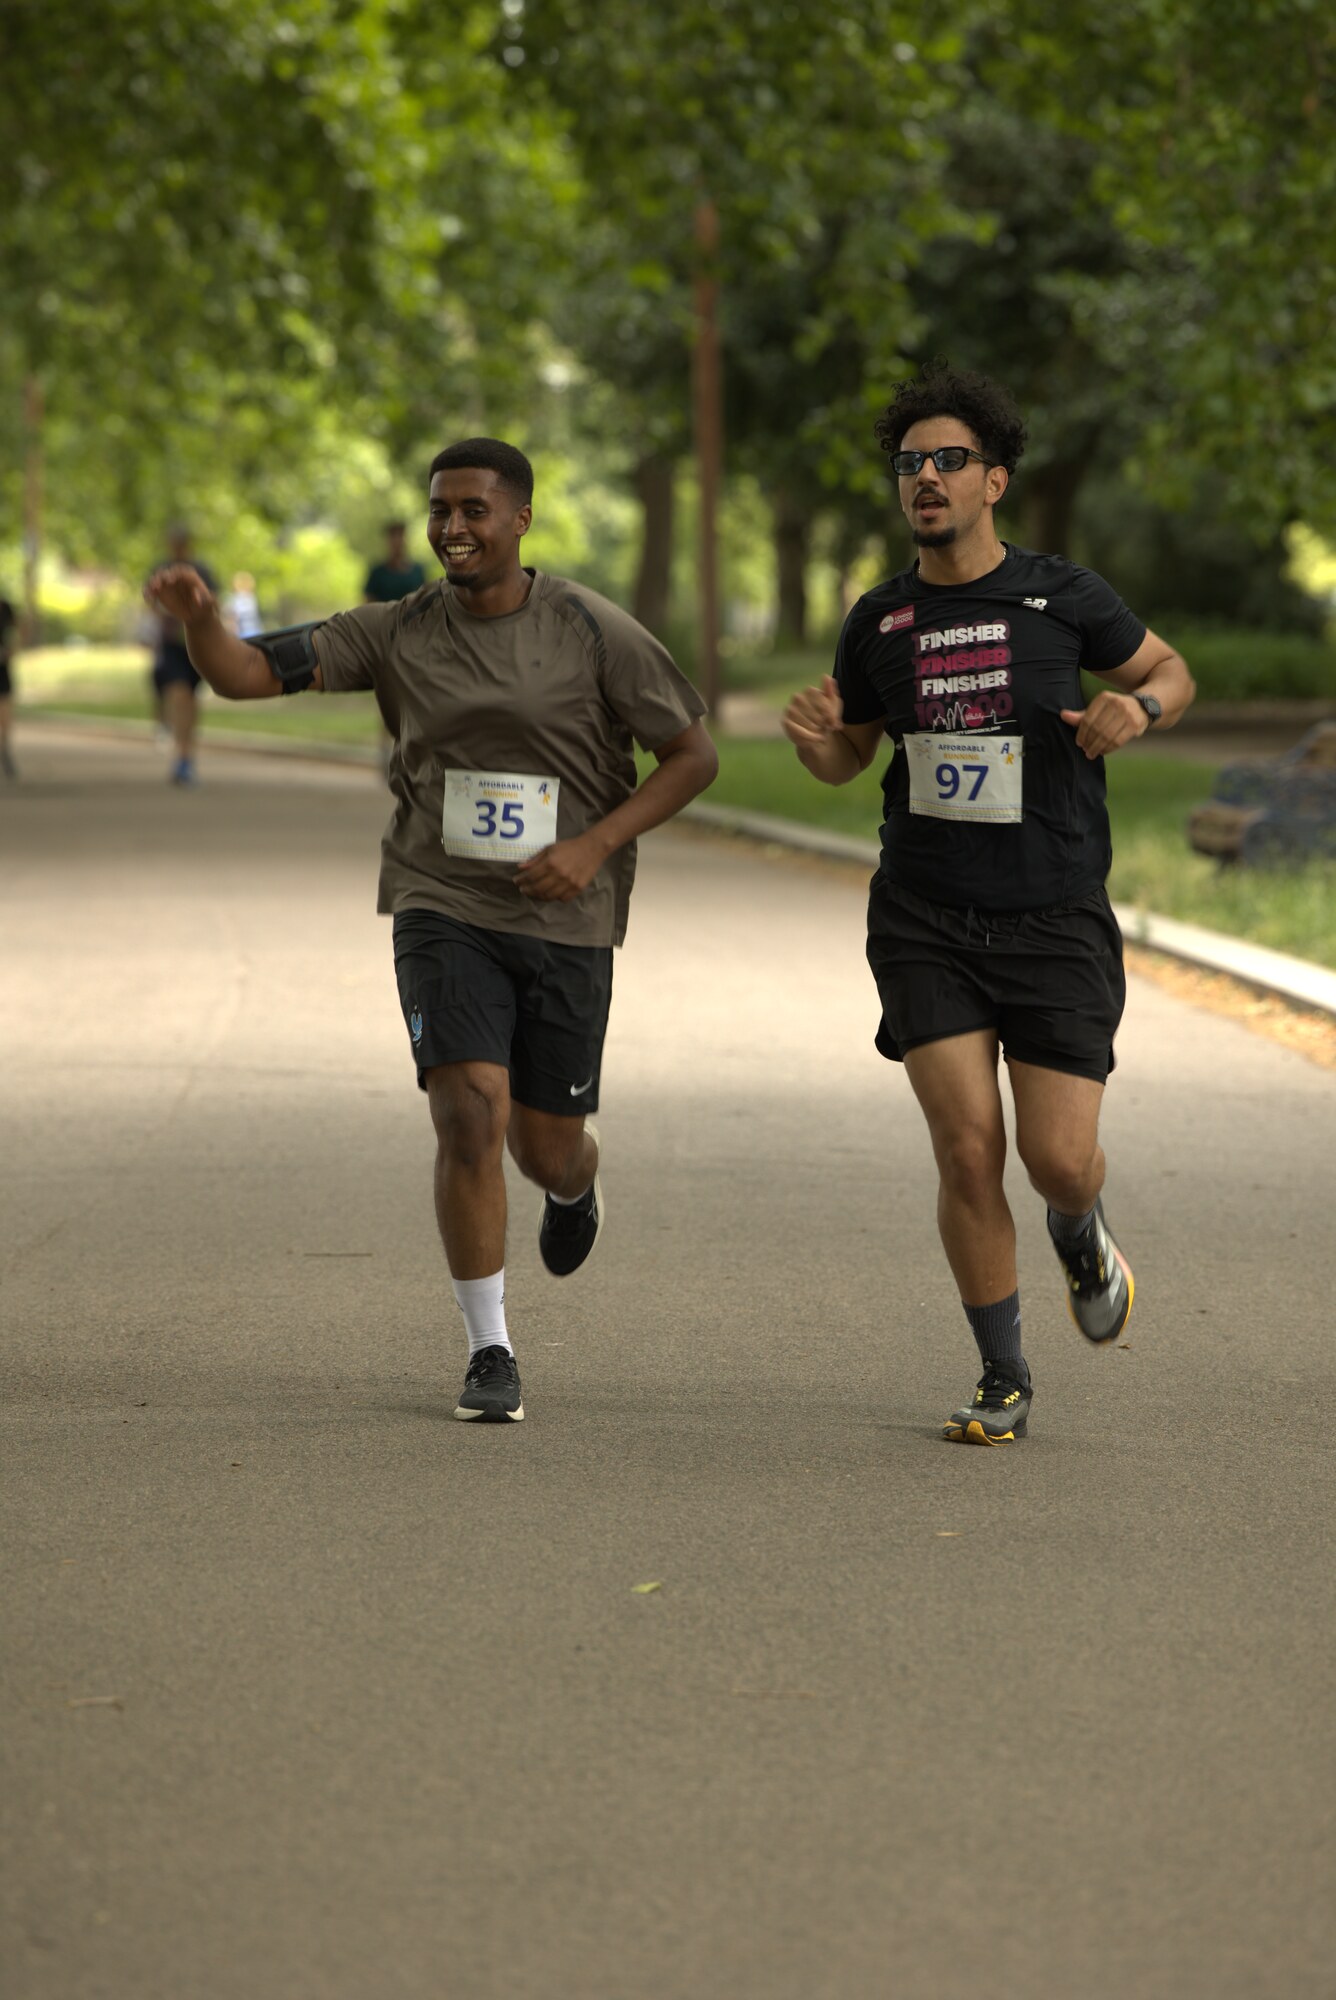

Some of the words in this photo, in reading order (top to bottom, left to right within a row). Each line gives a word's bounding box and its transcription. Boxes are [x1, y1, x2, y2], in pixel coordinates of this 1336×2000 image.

[920, 624, 1006, 651] FINISHER
[921, 648, 1007, 673] FINISHER
[922, 670, 1008, 696] FINISHER
[938, 744, 985, 752] AFFORDABLE
[479, 781, 524, 790] AFFORDABLE
[483, 789, 518, 798] RUNNING
[935, 763, 989, 801] 97
[472, 800, 525, 839] 35
